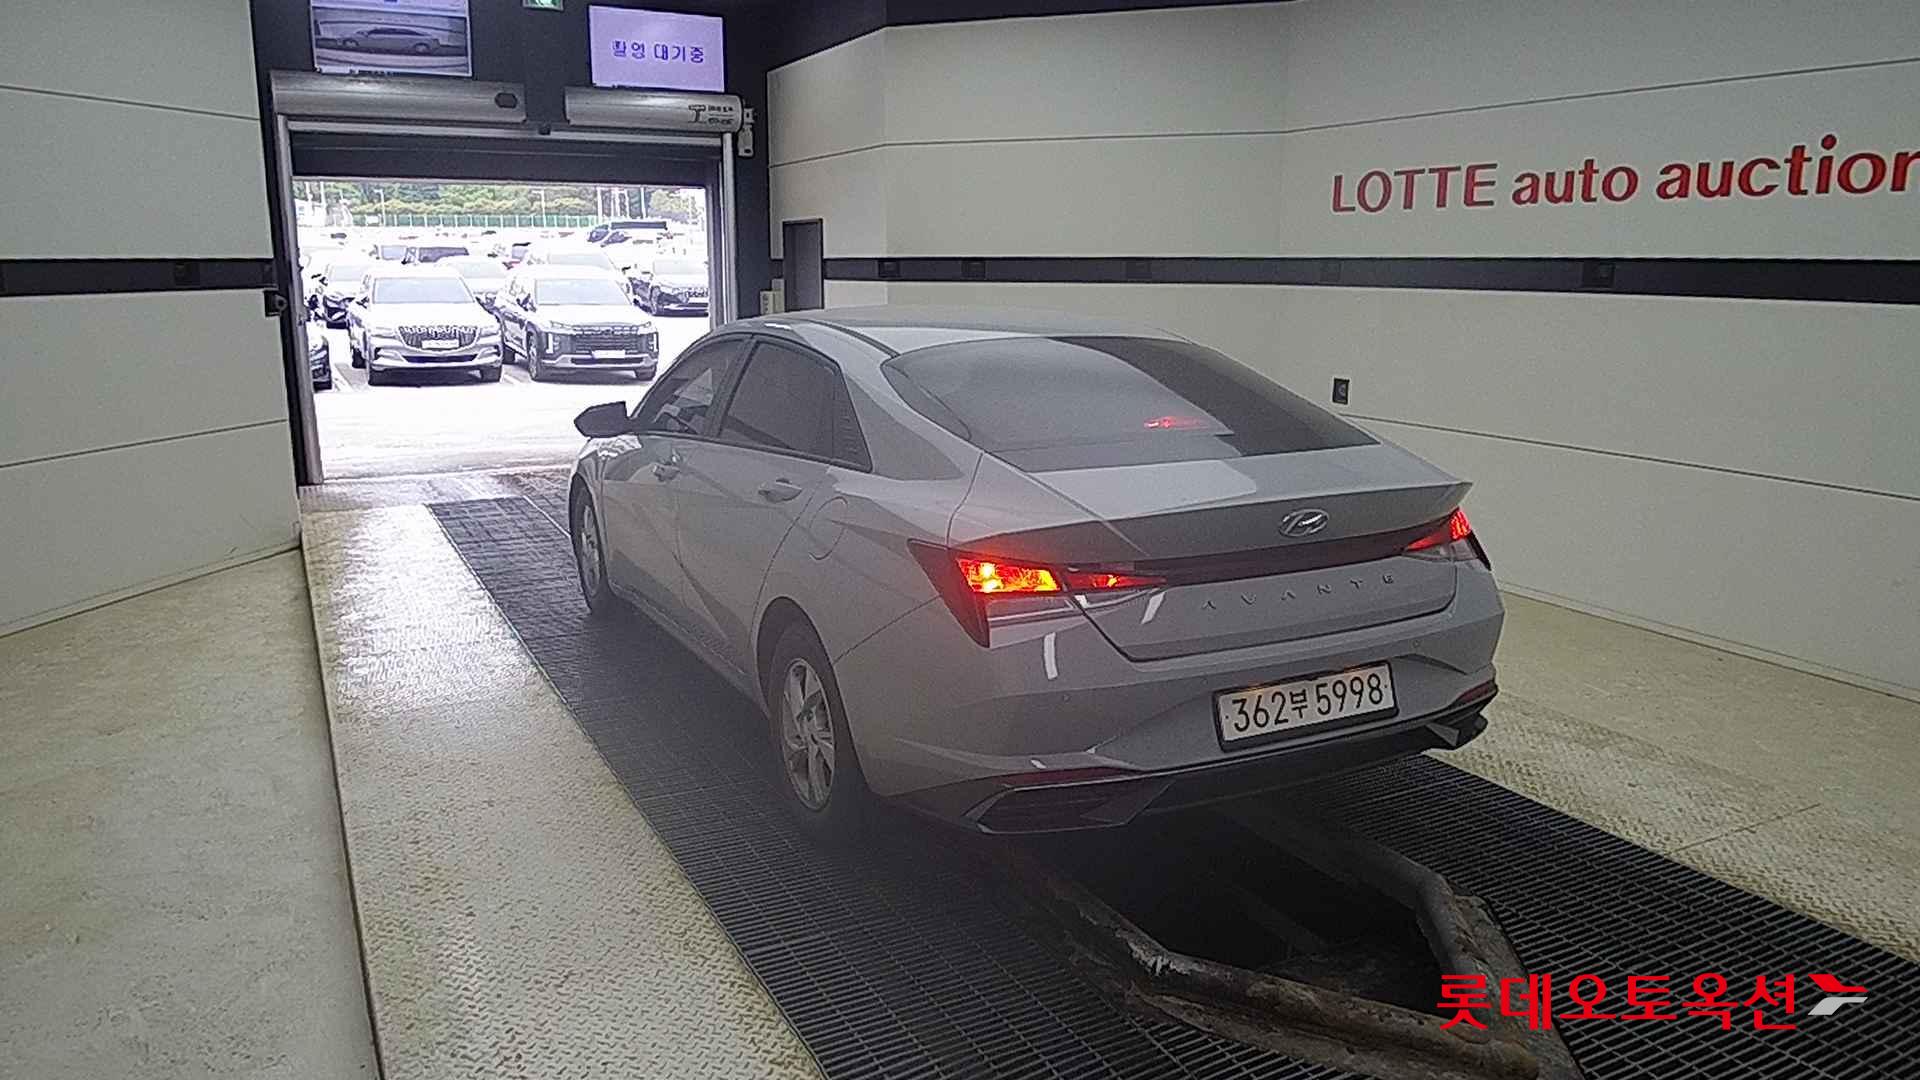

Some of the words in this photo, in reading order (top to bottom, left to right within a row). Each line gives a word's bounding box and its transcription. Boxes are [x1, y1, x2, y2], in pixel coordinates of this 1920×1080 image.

[654, 43, 704, 64] 대기중
[1331, 163, 1498, 212] LOTTE
[1512, 159, 1639, 205] auto
